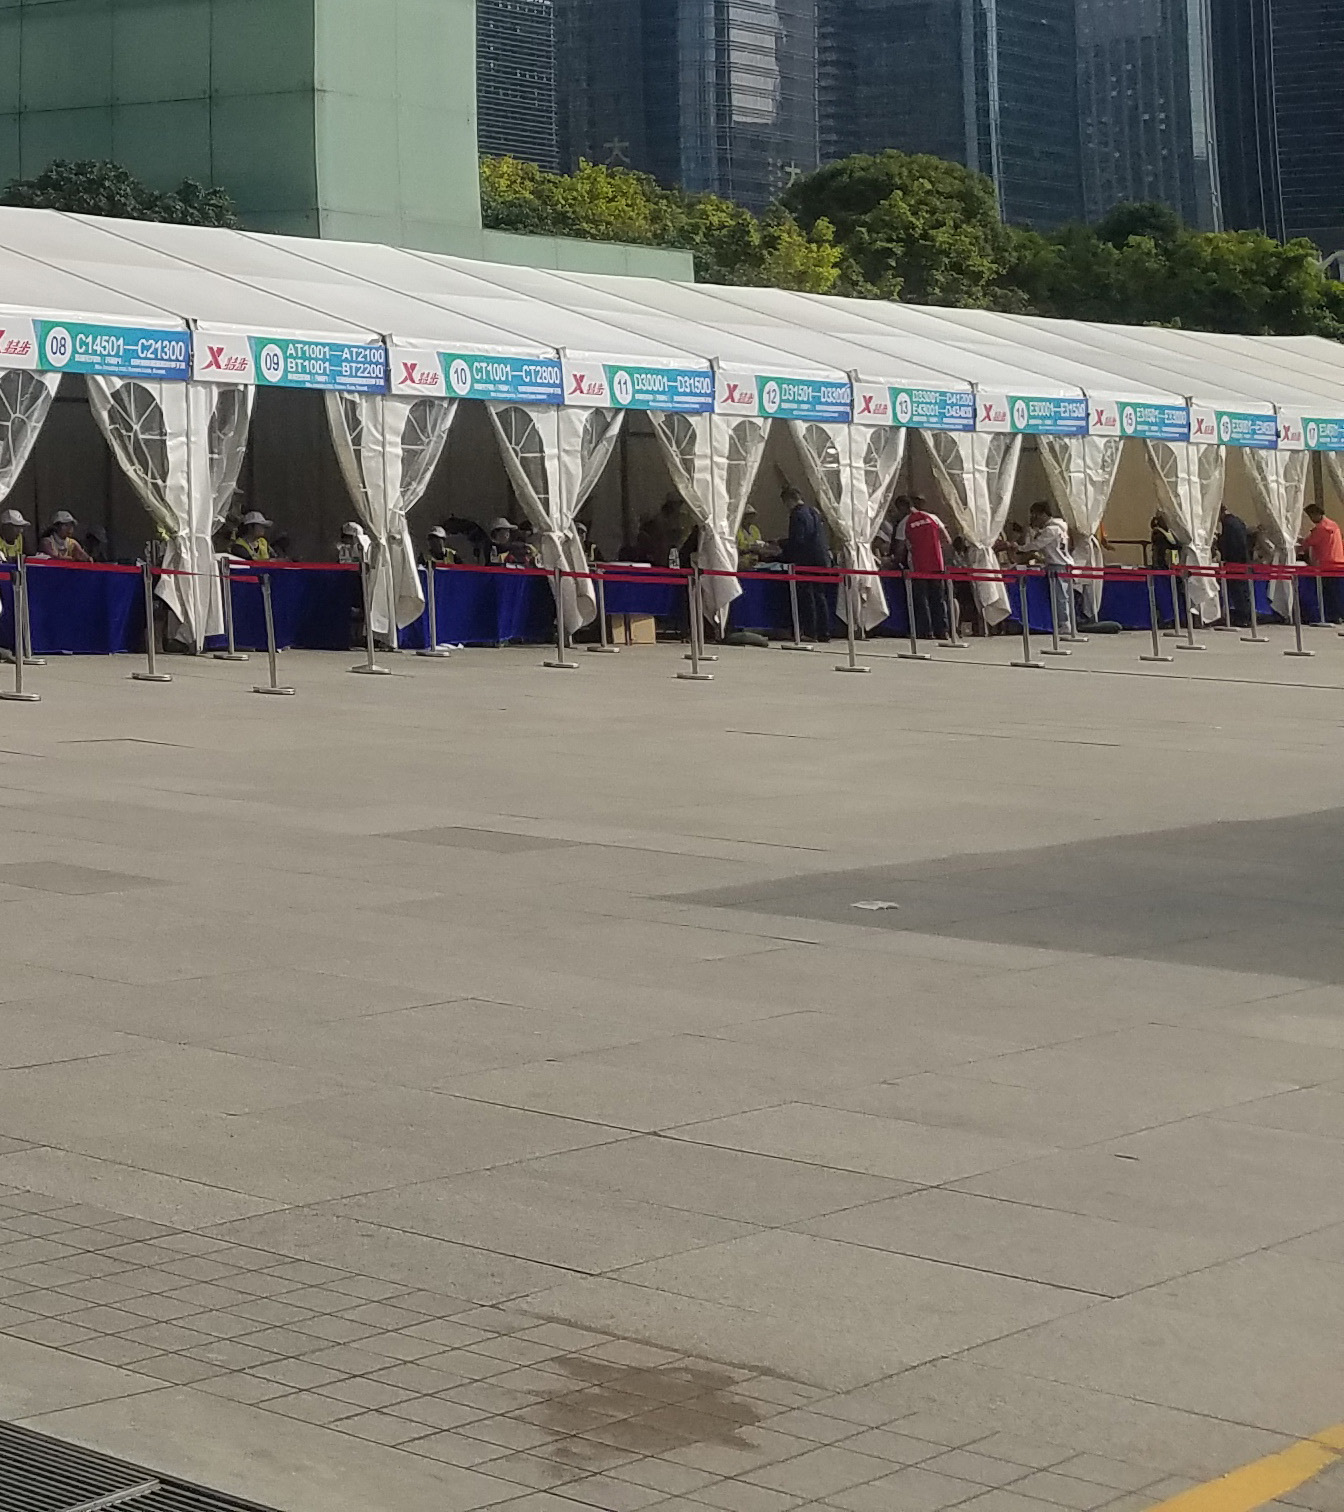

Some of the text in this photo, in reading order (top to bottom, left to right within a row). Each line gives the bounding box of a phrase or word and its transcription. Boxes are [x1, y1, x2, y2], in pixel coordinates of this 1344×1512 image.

[50, 336, 67, 356] 08
[265, 352, 280, 372] 09
[454, 367, 467, 385] 10
[617, 378, 629, 395] 11
[766, 388, 777, 405] 12
[898, 400, 909, 415] 13
[1016, 406, 1026, 422] 14
